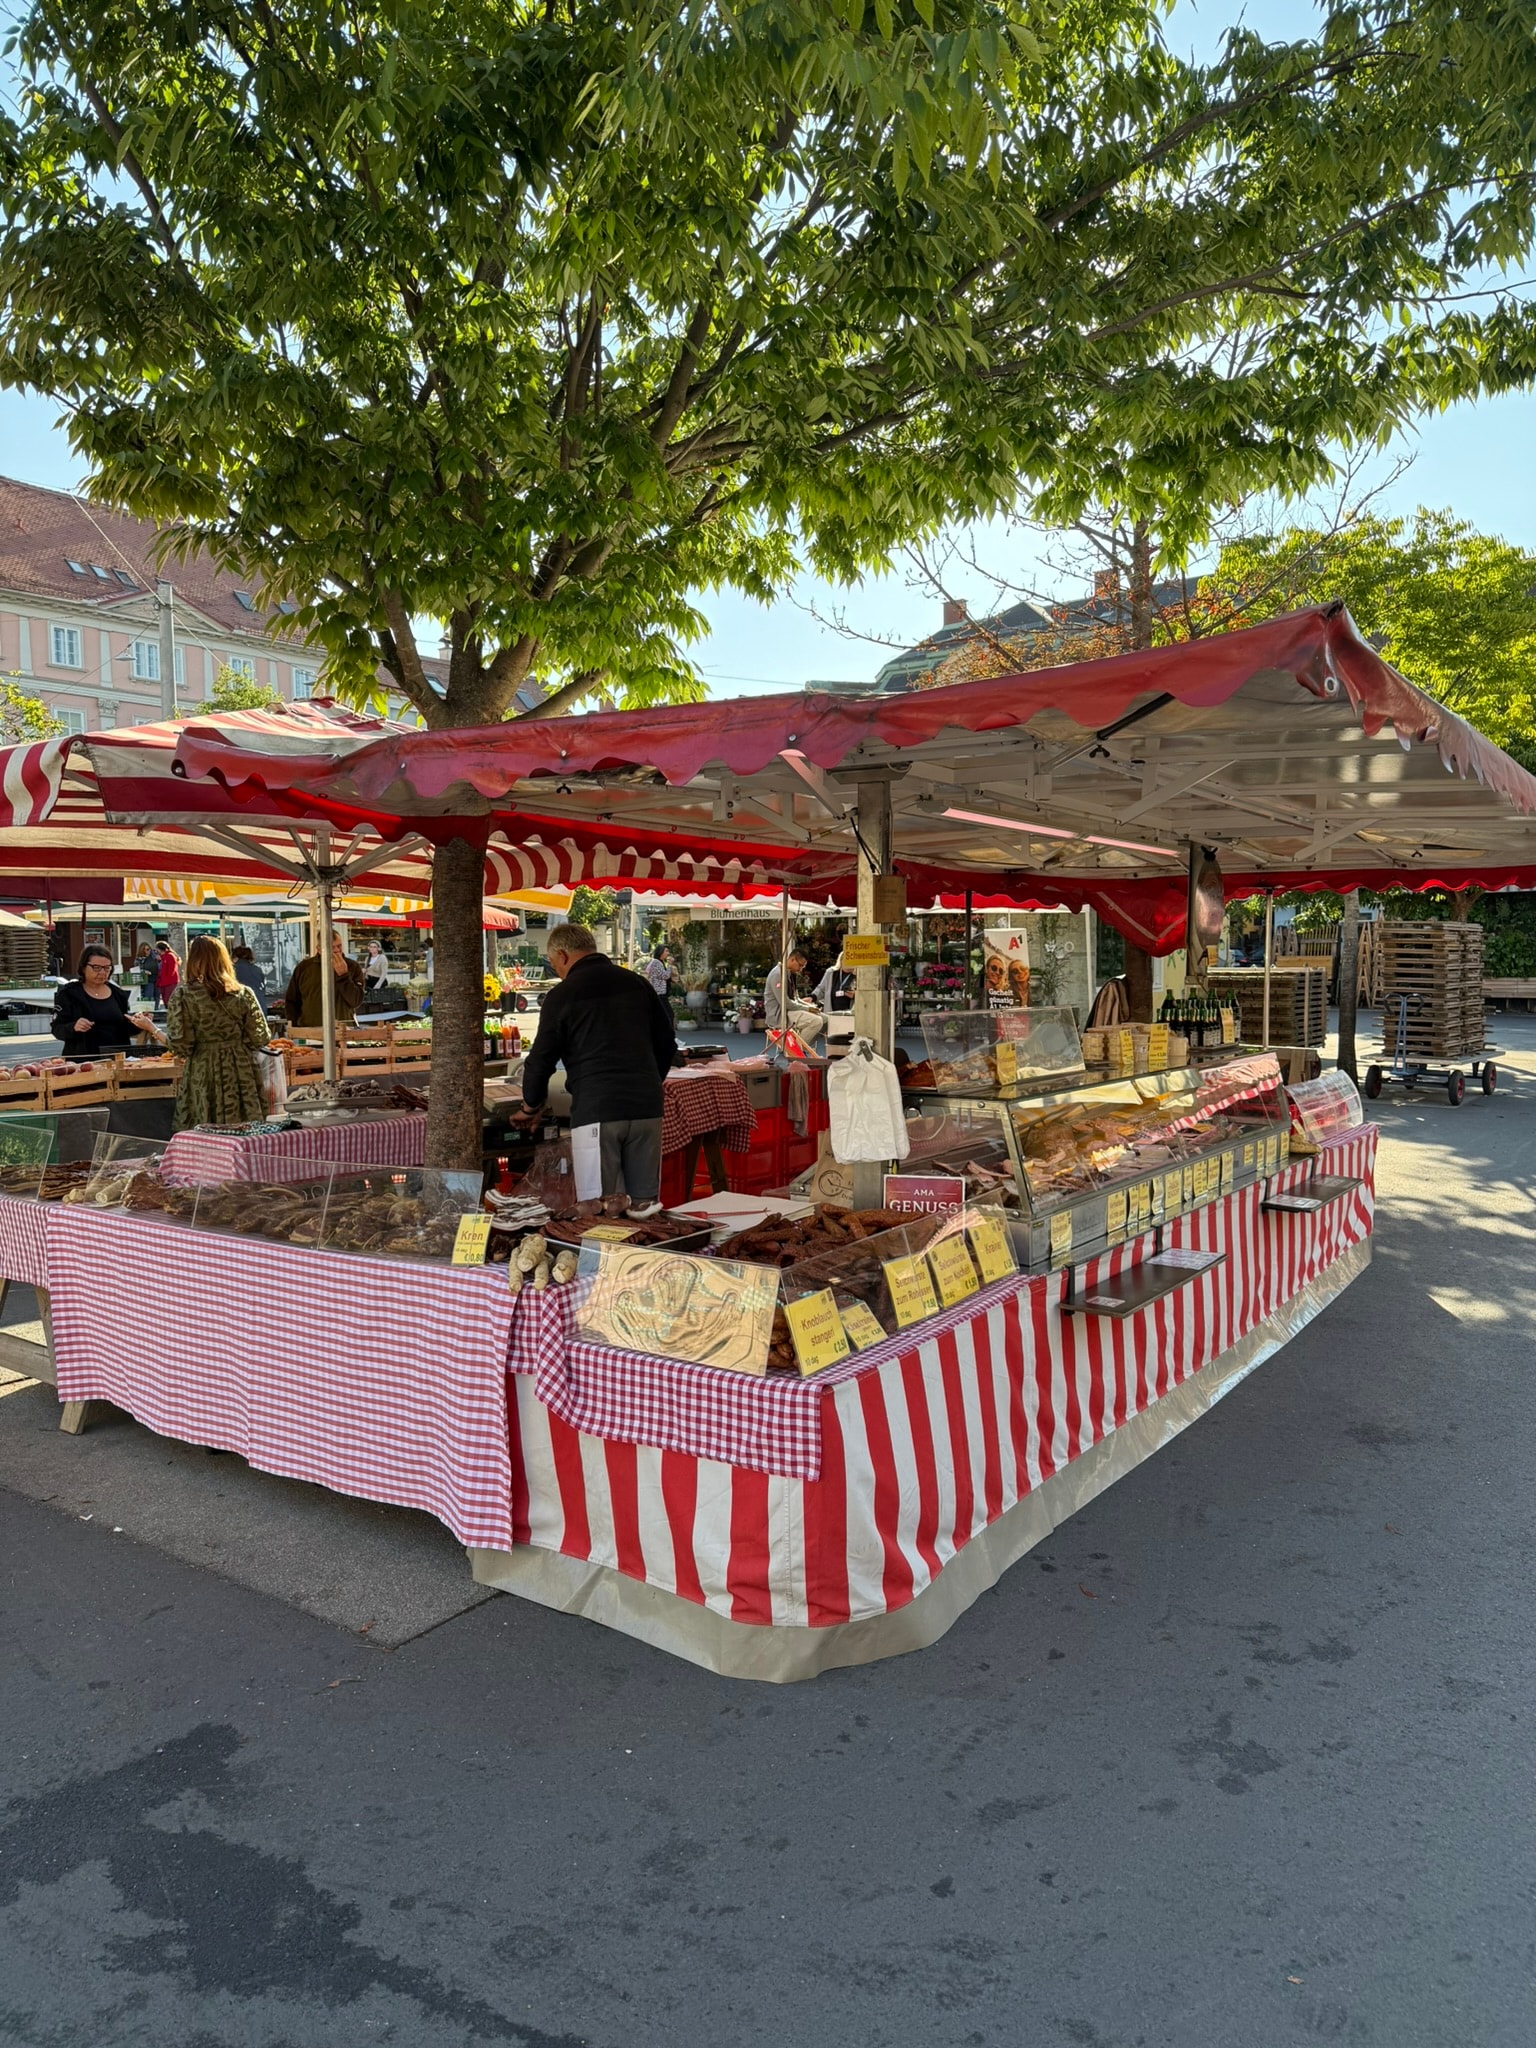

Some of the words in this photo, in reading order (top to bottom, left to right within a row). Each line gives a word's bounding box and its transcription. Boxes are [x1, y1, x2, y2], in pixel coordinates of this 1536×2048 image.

[710, 908, 771, 919] Blumenhaus
[845, 941, 871, 950] Frischer
[1008, 934, 1023, 951] A1
[913, 1189, 935, 1197] AMA
[889, 1201, 958, 1214] GENUSS
[461, 1230, 483, 1241] Kren
